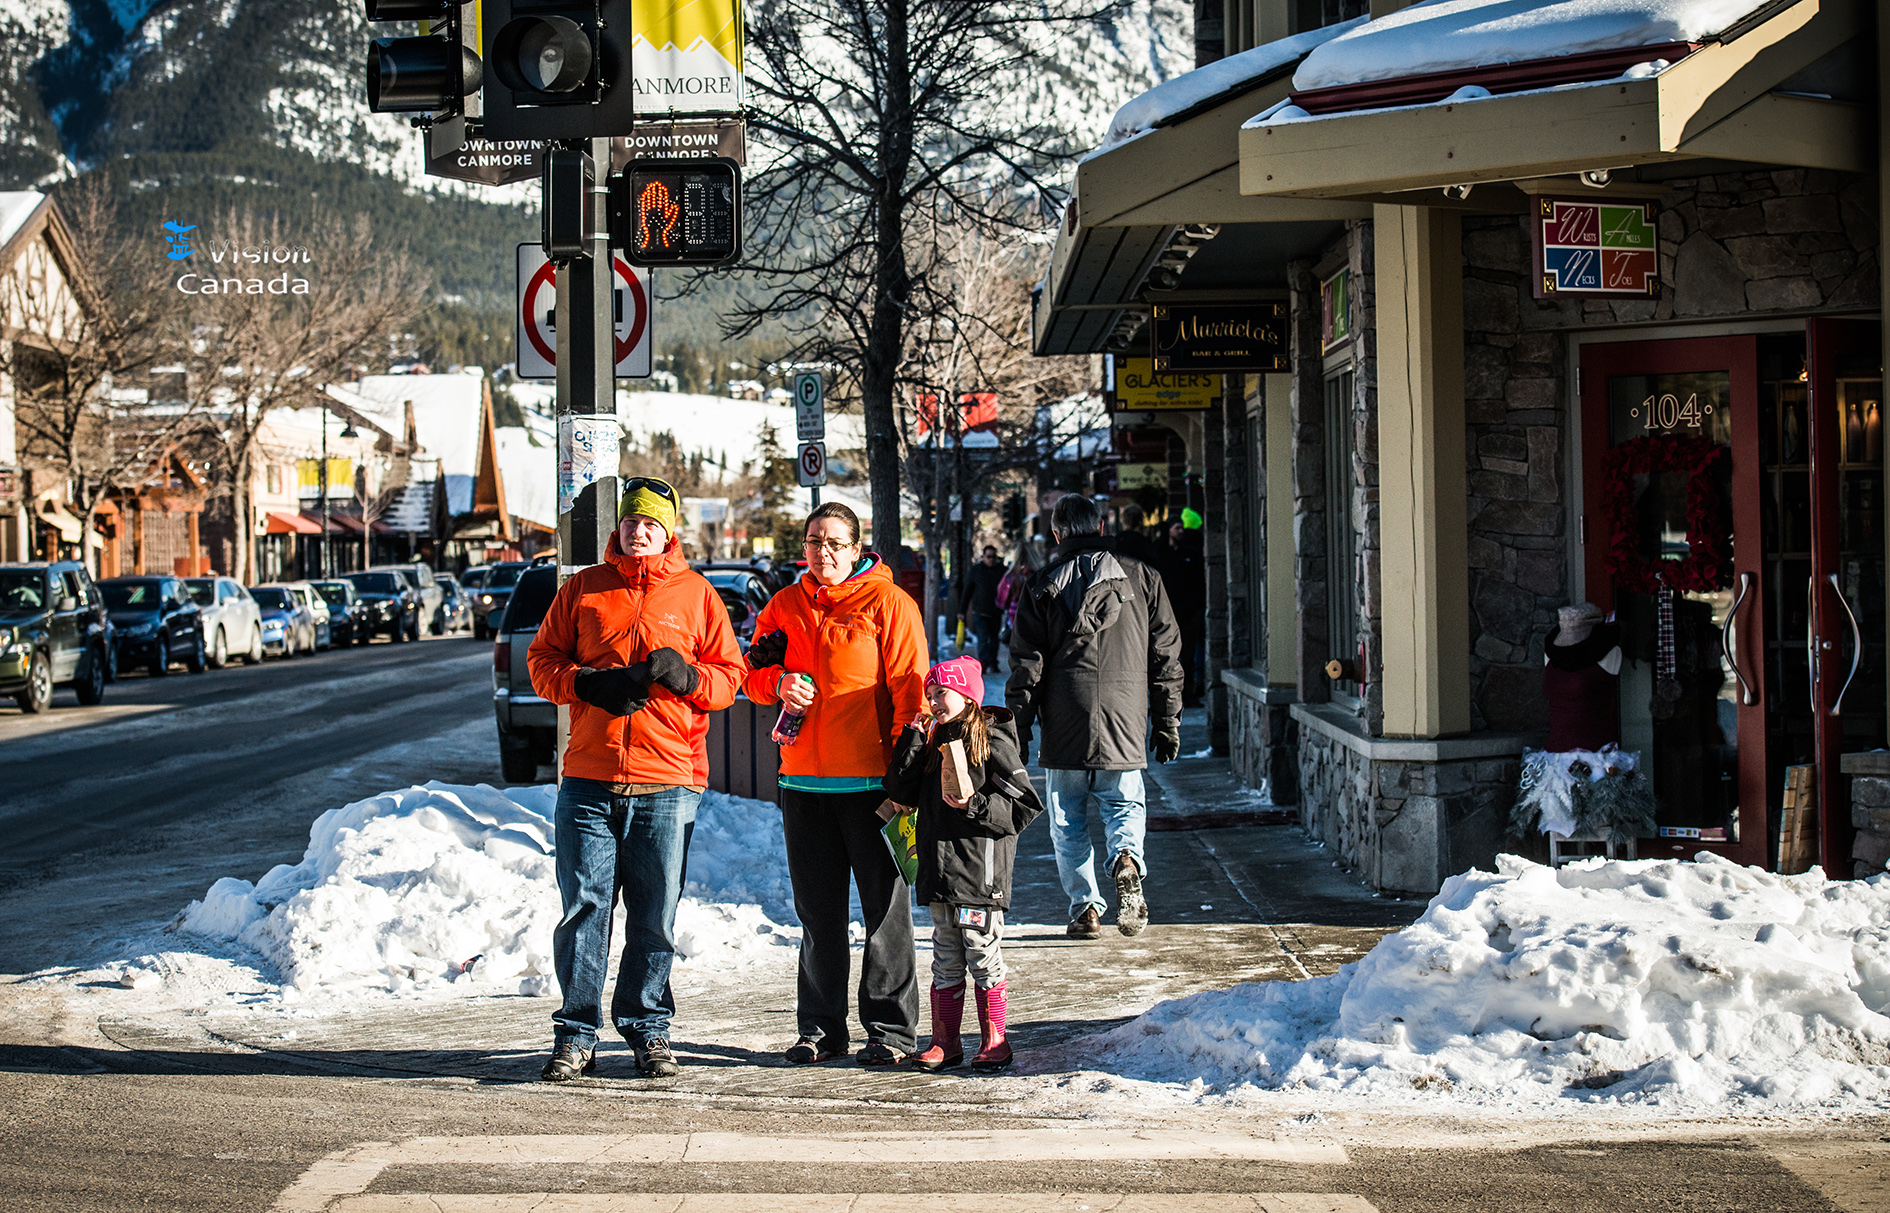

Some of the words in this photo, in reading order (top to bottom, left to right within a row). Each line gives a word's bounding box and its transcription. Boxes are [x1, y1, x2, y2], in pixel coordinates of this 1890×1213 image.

[632, 76, 732, 96] ANMORE
[458, 139, 541, 152] OWNTOWN
[624, 133, 719, 149] DOWNTOWN
[457, 154, 533, 167] CANMORE
[1124, 373, 1212, 388] GLACIER'S
[1156, 390, 1181, 400] edge
